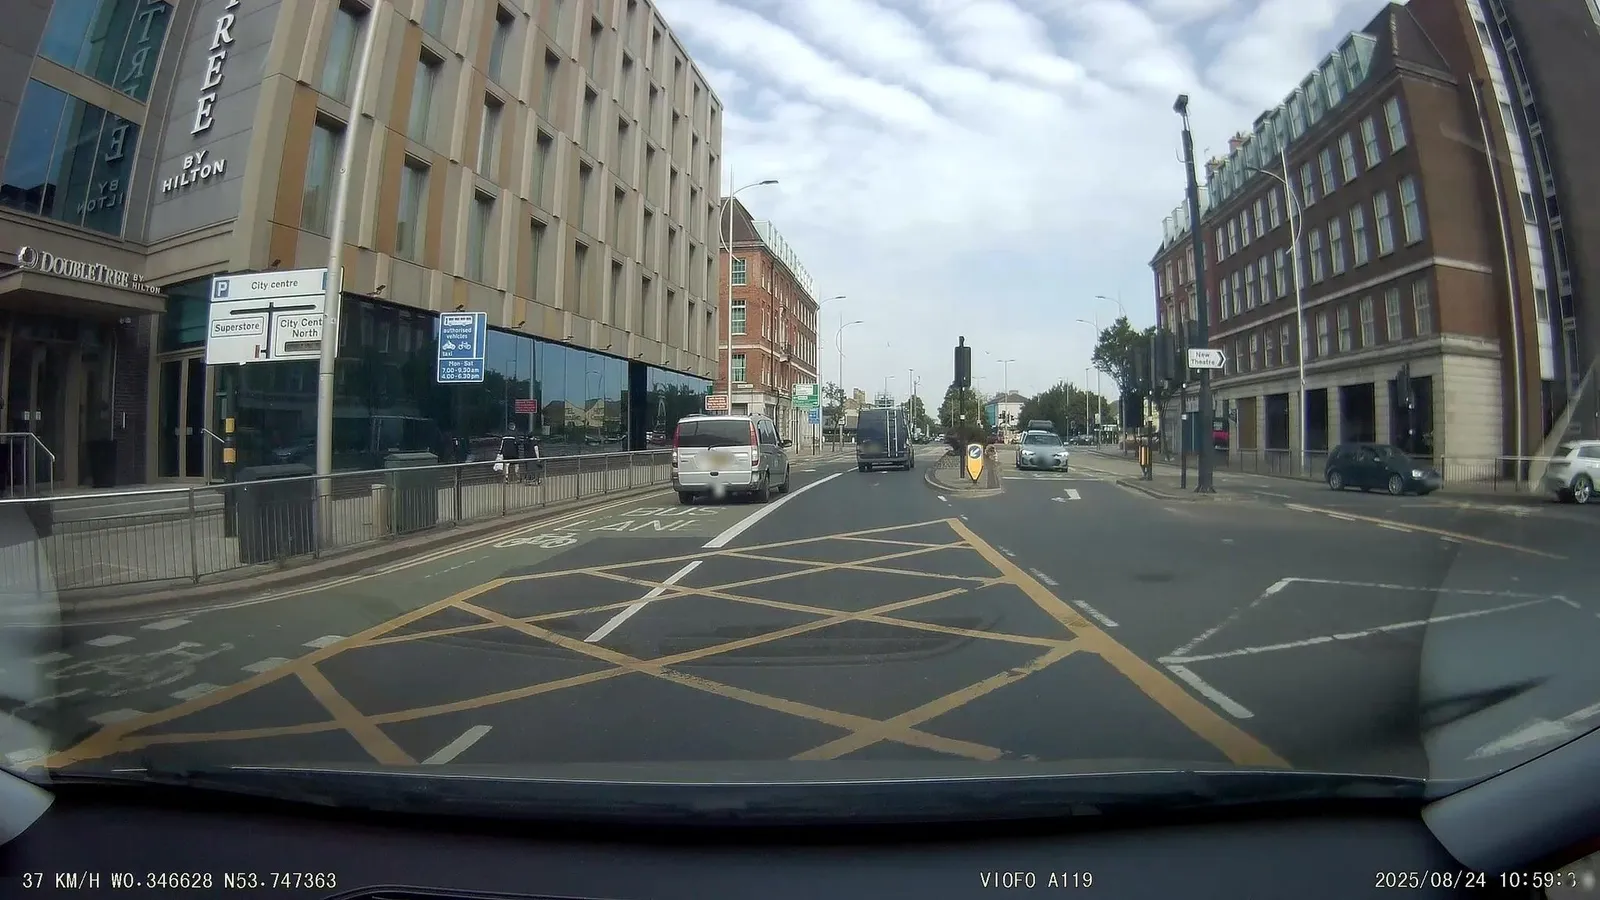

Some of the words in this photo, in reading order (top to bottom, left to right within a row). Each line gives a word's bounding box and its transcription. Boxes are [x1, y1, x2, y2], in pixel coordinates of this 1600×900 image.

[190, 0, 240, 136] REE
[183, 150, 208, 170] BY
[162, 158, 226, 193] HILTON
[132, 273, 144, 282] BY
[131, 281, 161, 294] HILTON
[251, 281, 270, 291] City
[270, 279, 299, 289] centre
[214, 321, 260, 334] Superstore
[280, 319, 299, 329] City
[301, 317, 323, 327] Cent
[292, 328, 319, 338] North
[618, 506, 725, 517] BUS
[553, 519, 703, 532] LANE
